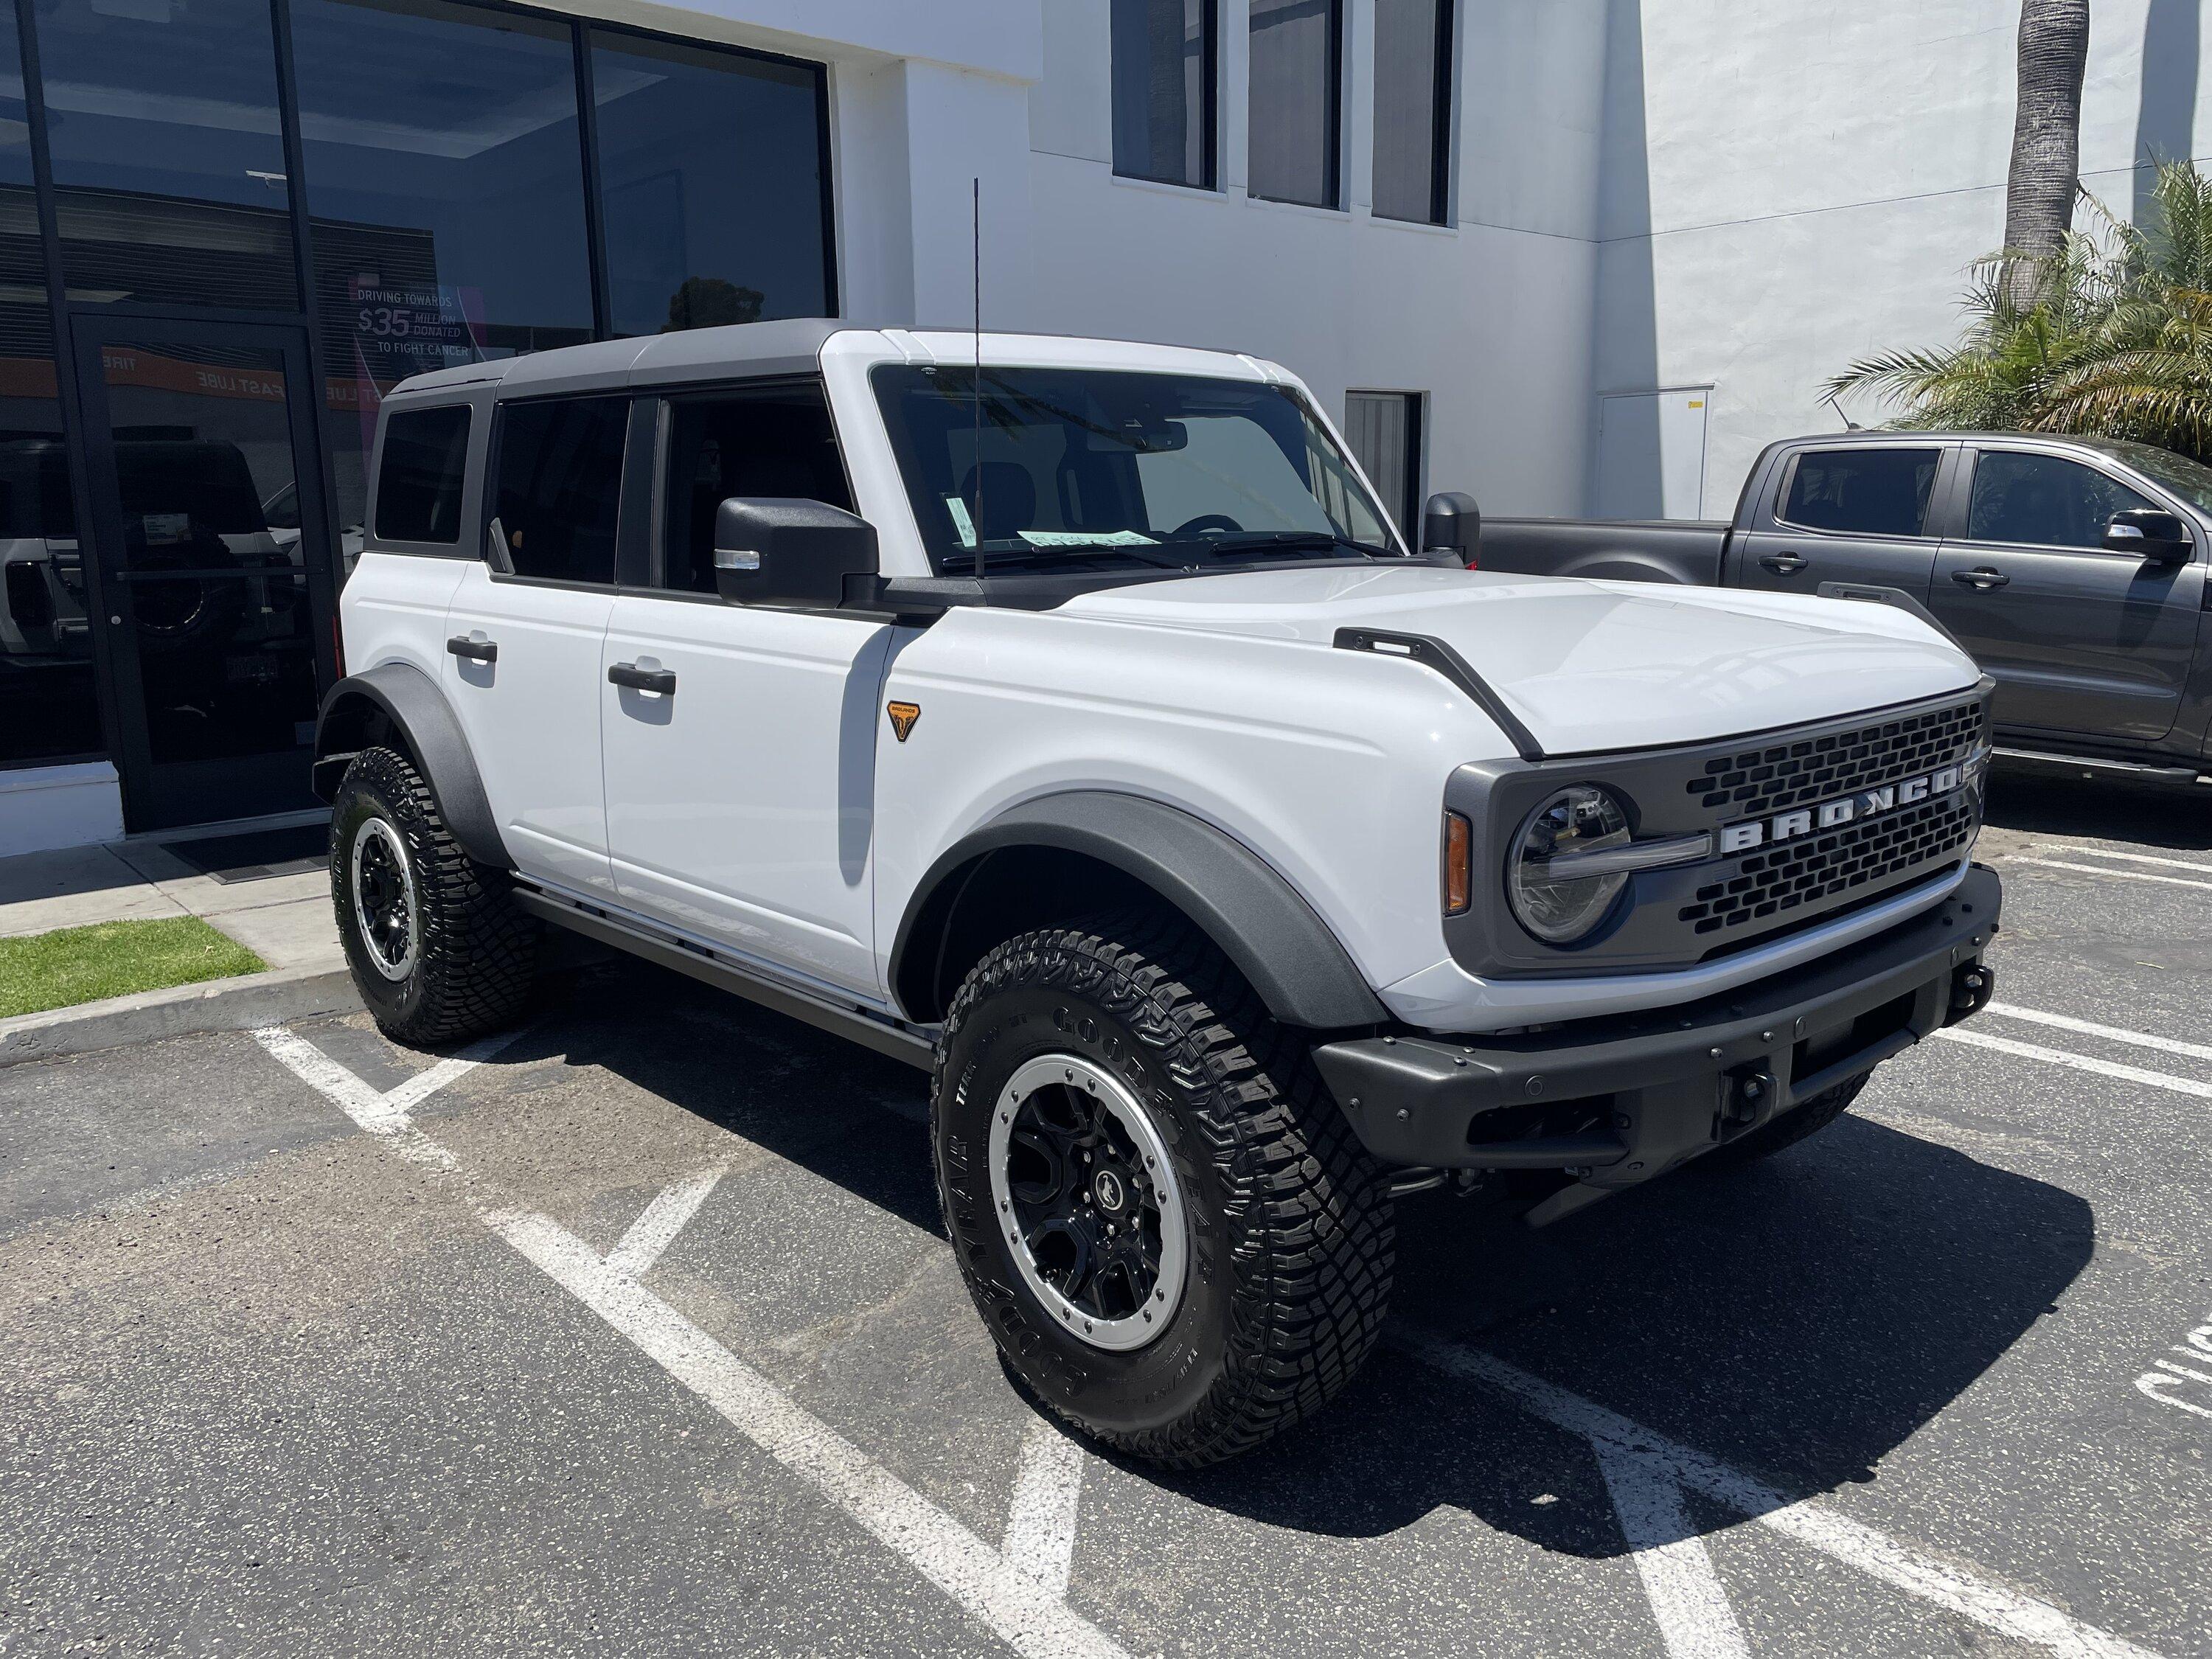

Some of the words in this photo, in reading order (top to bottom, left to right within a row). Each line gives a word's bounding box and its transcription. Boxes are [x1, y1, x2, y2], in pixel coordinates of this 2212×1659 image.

[358, 290, 402, 303] DRIVING
[404, 293, 452, 307] TOWARDS
[358, 307, 411, 337] $35
[414, 312, 456, 325] MILLION
[413, 325, 461, 338] DONATED
[378, 341, 392, 352] TO
[394, 342, 425, 355] FIGHT
[428, 344, 470, 358] CANCER
[891, 706, 916, 714] BADLANDS
[1720, 767, 1959, 853] BRONCO
